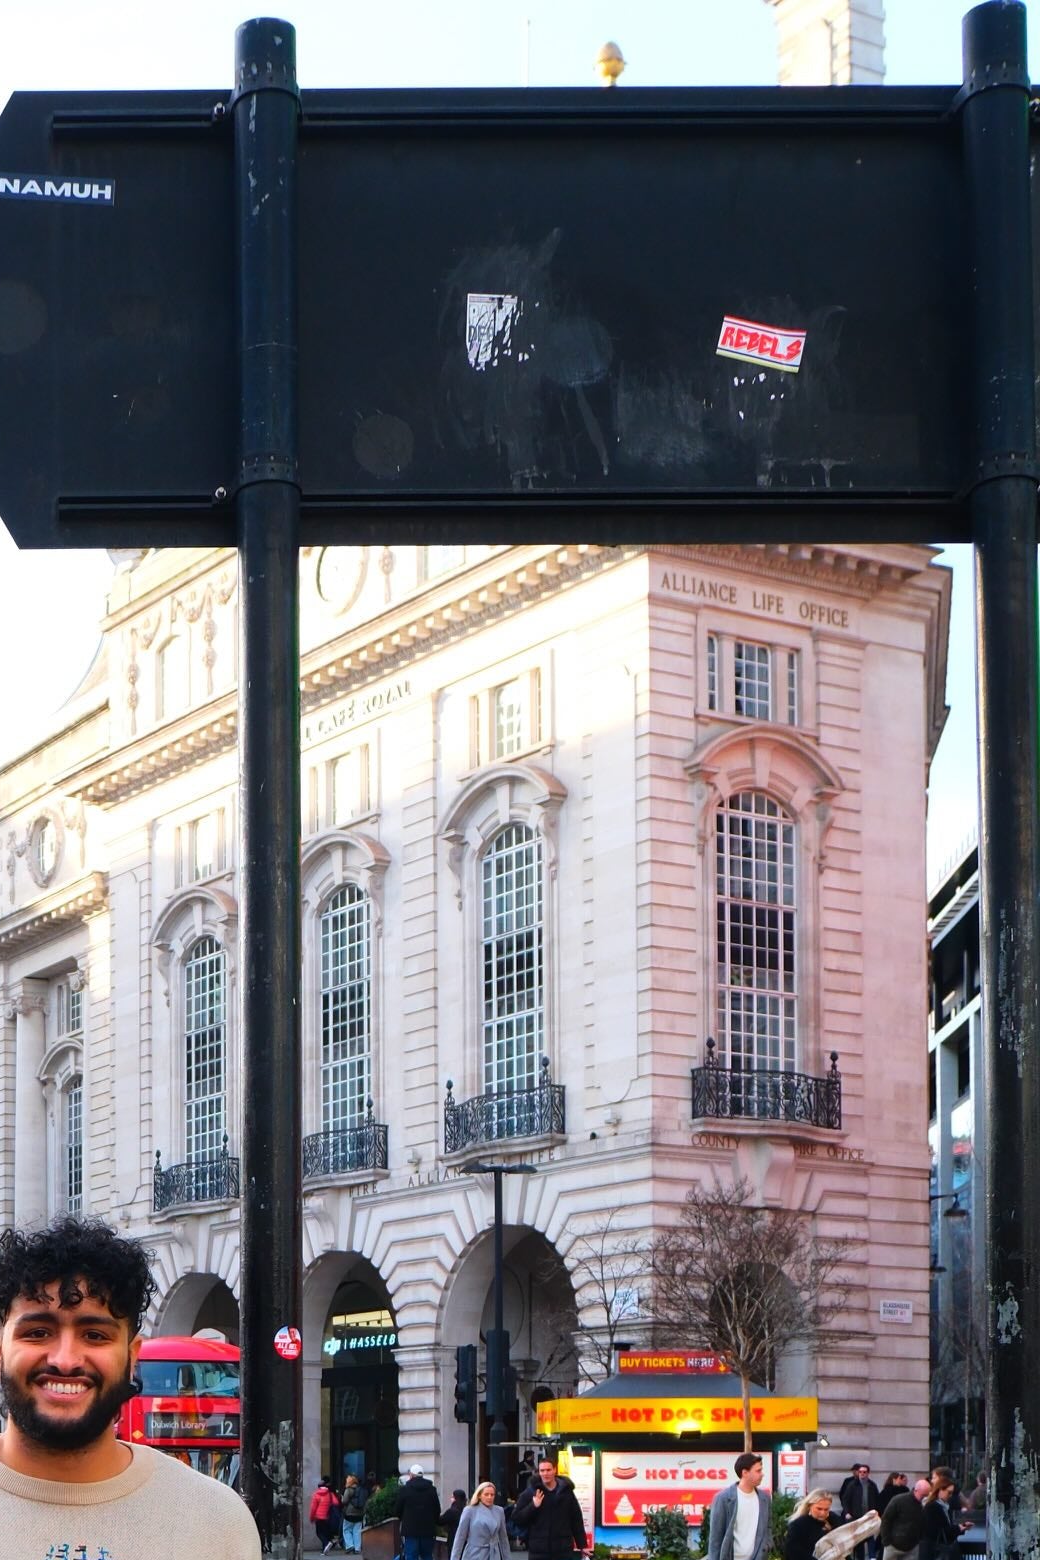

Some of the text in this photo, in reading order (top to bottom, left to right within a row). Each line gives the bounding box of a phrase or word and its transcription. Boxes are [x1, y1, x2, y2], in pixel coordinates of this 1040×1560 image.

[720, 326, 802, 360] REBELS
[661, 571, 850, 628] ALLIANCE LIFE OFFICE
[691, 1133, 865, 1160] COUNTY FIRE OFFICE
[348, 1182, 379, 1198] FIRE
[620, 1357, 641, 1368] BUY
[643, 1357, 686, 1368] TICKETS
[611, 1408, 655, 1423] HOT
[660, 1408, 705, 1423] DOG
[151, 1420, 233, 1436] Dulwich Library 12
[644, 1469, 729, 1481] HOT DOGS
